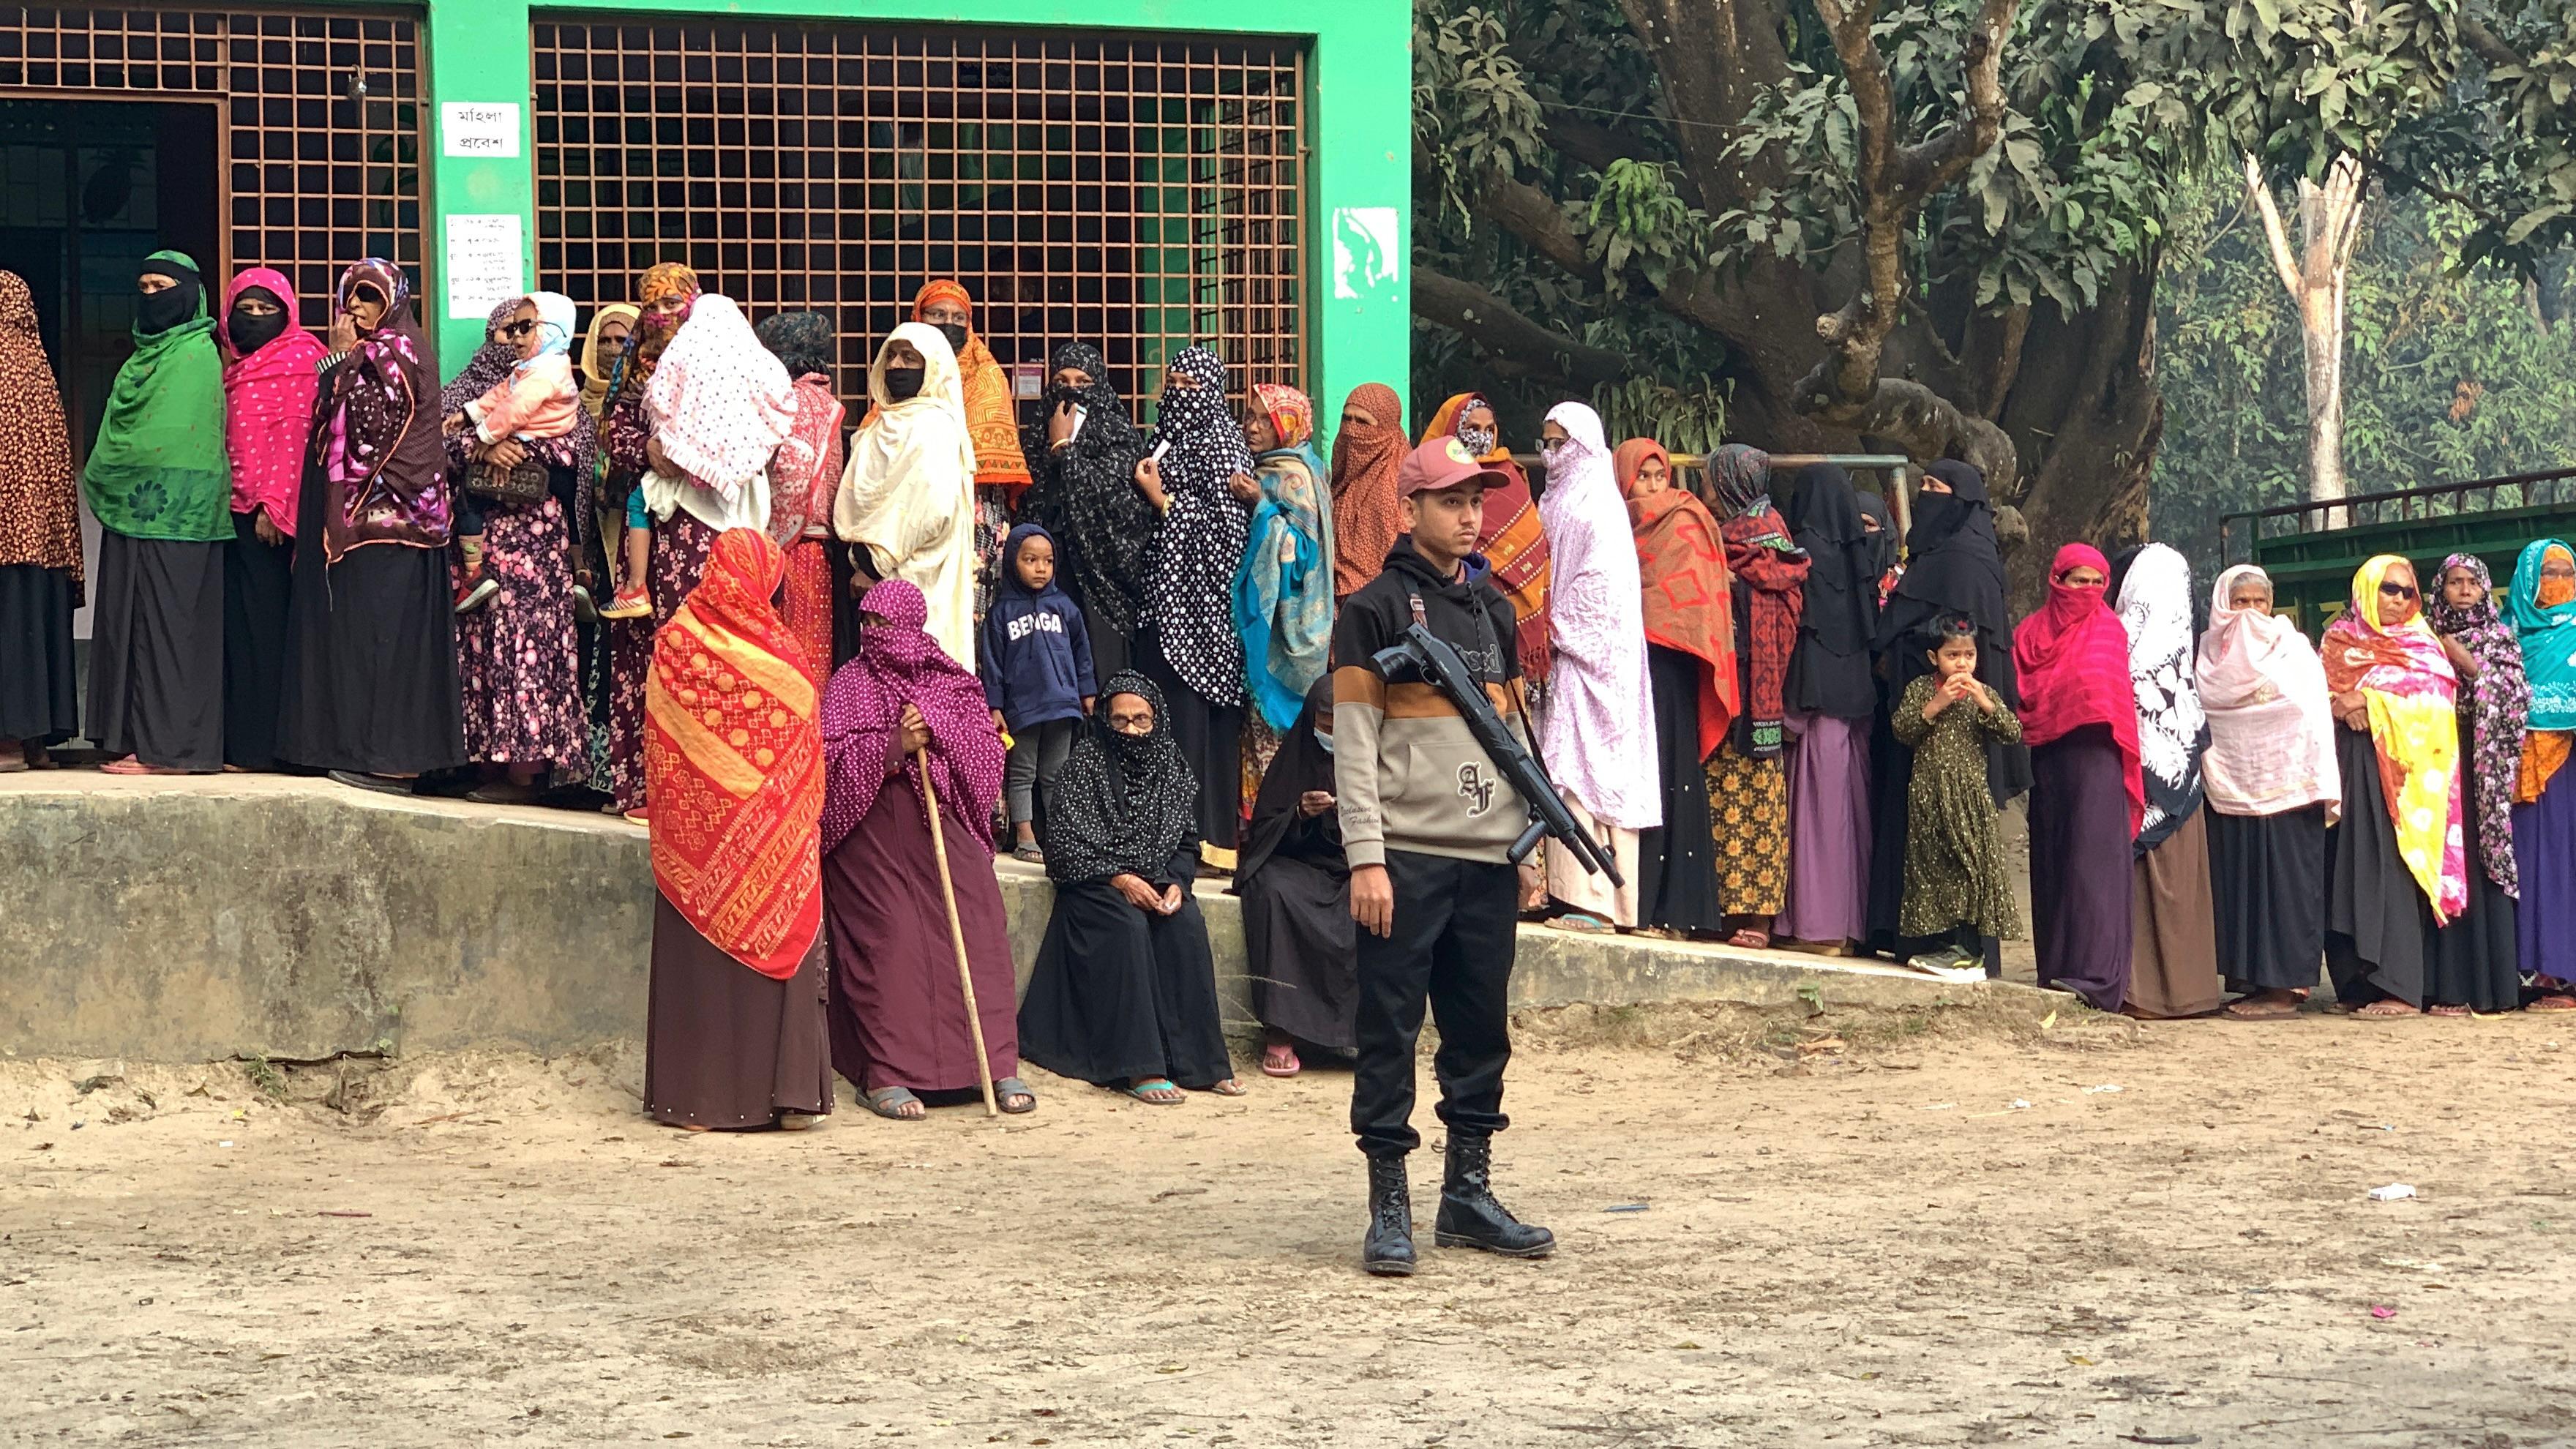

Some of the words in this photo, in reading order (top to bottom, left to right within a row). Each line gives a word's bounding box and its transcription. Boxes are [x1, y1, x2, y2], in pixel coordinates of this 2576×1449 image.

[458, 108, 502, 123] মহিলা
[460, 138, 503, 149] প্রবেশ
[1007, 612, 1062, 641] BENGA
